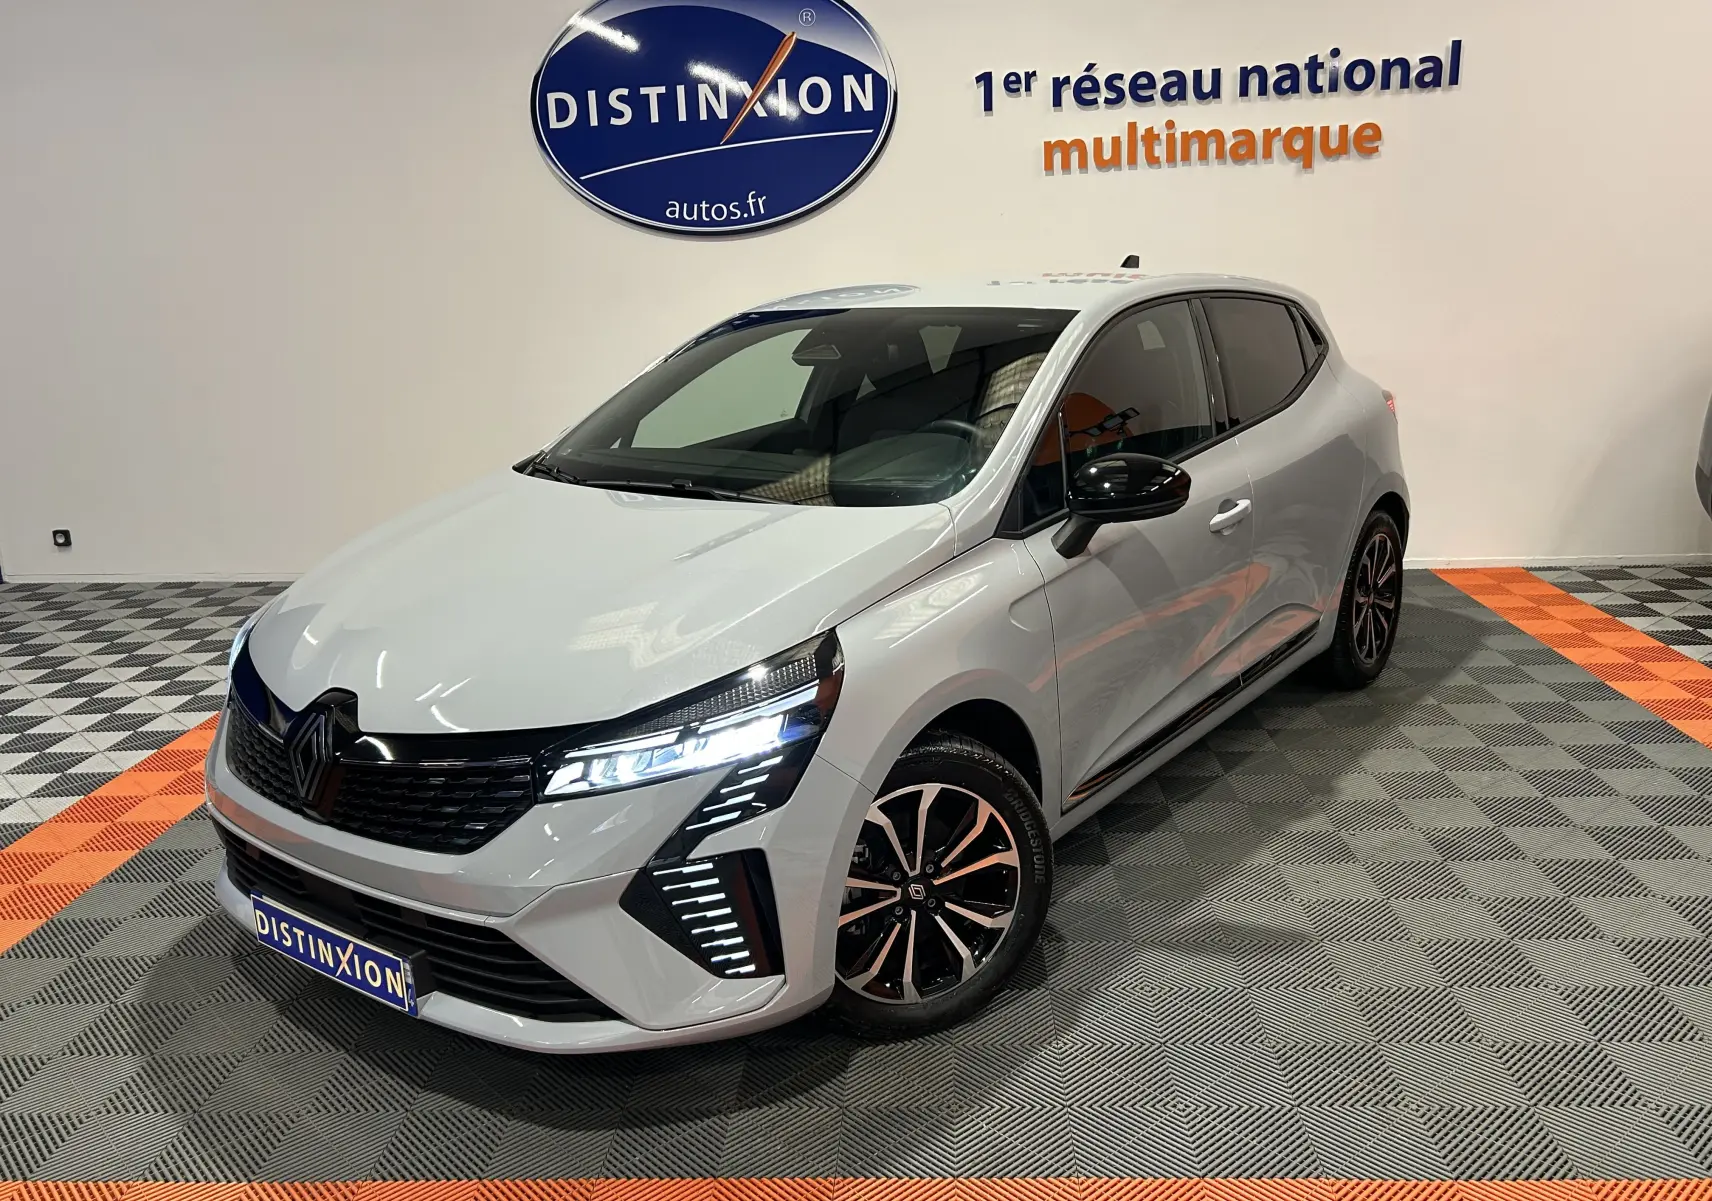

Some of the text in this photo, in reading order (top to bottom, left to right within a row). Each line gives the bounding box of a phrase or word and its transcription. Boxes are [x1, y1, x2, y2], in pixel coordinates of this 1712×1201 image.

[546, 31, 874, 144] DISTINXION
[974, 39, 1463, 112] 1er réseau national
[1043, 119, 1383, 171] multimarque
[665, 191, 767, 221] autos.fr
[1003, 788, 1046, 884] BRIDGESTONE
[254, 909, 404, 999] DISTINXION
